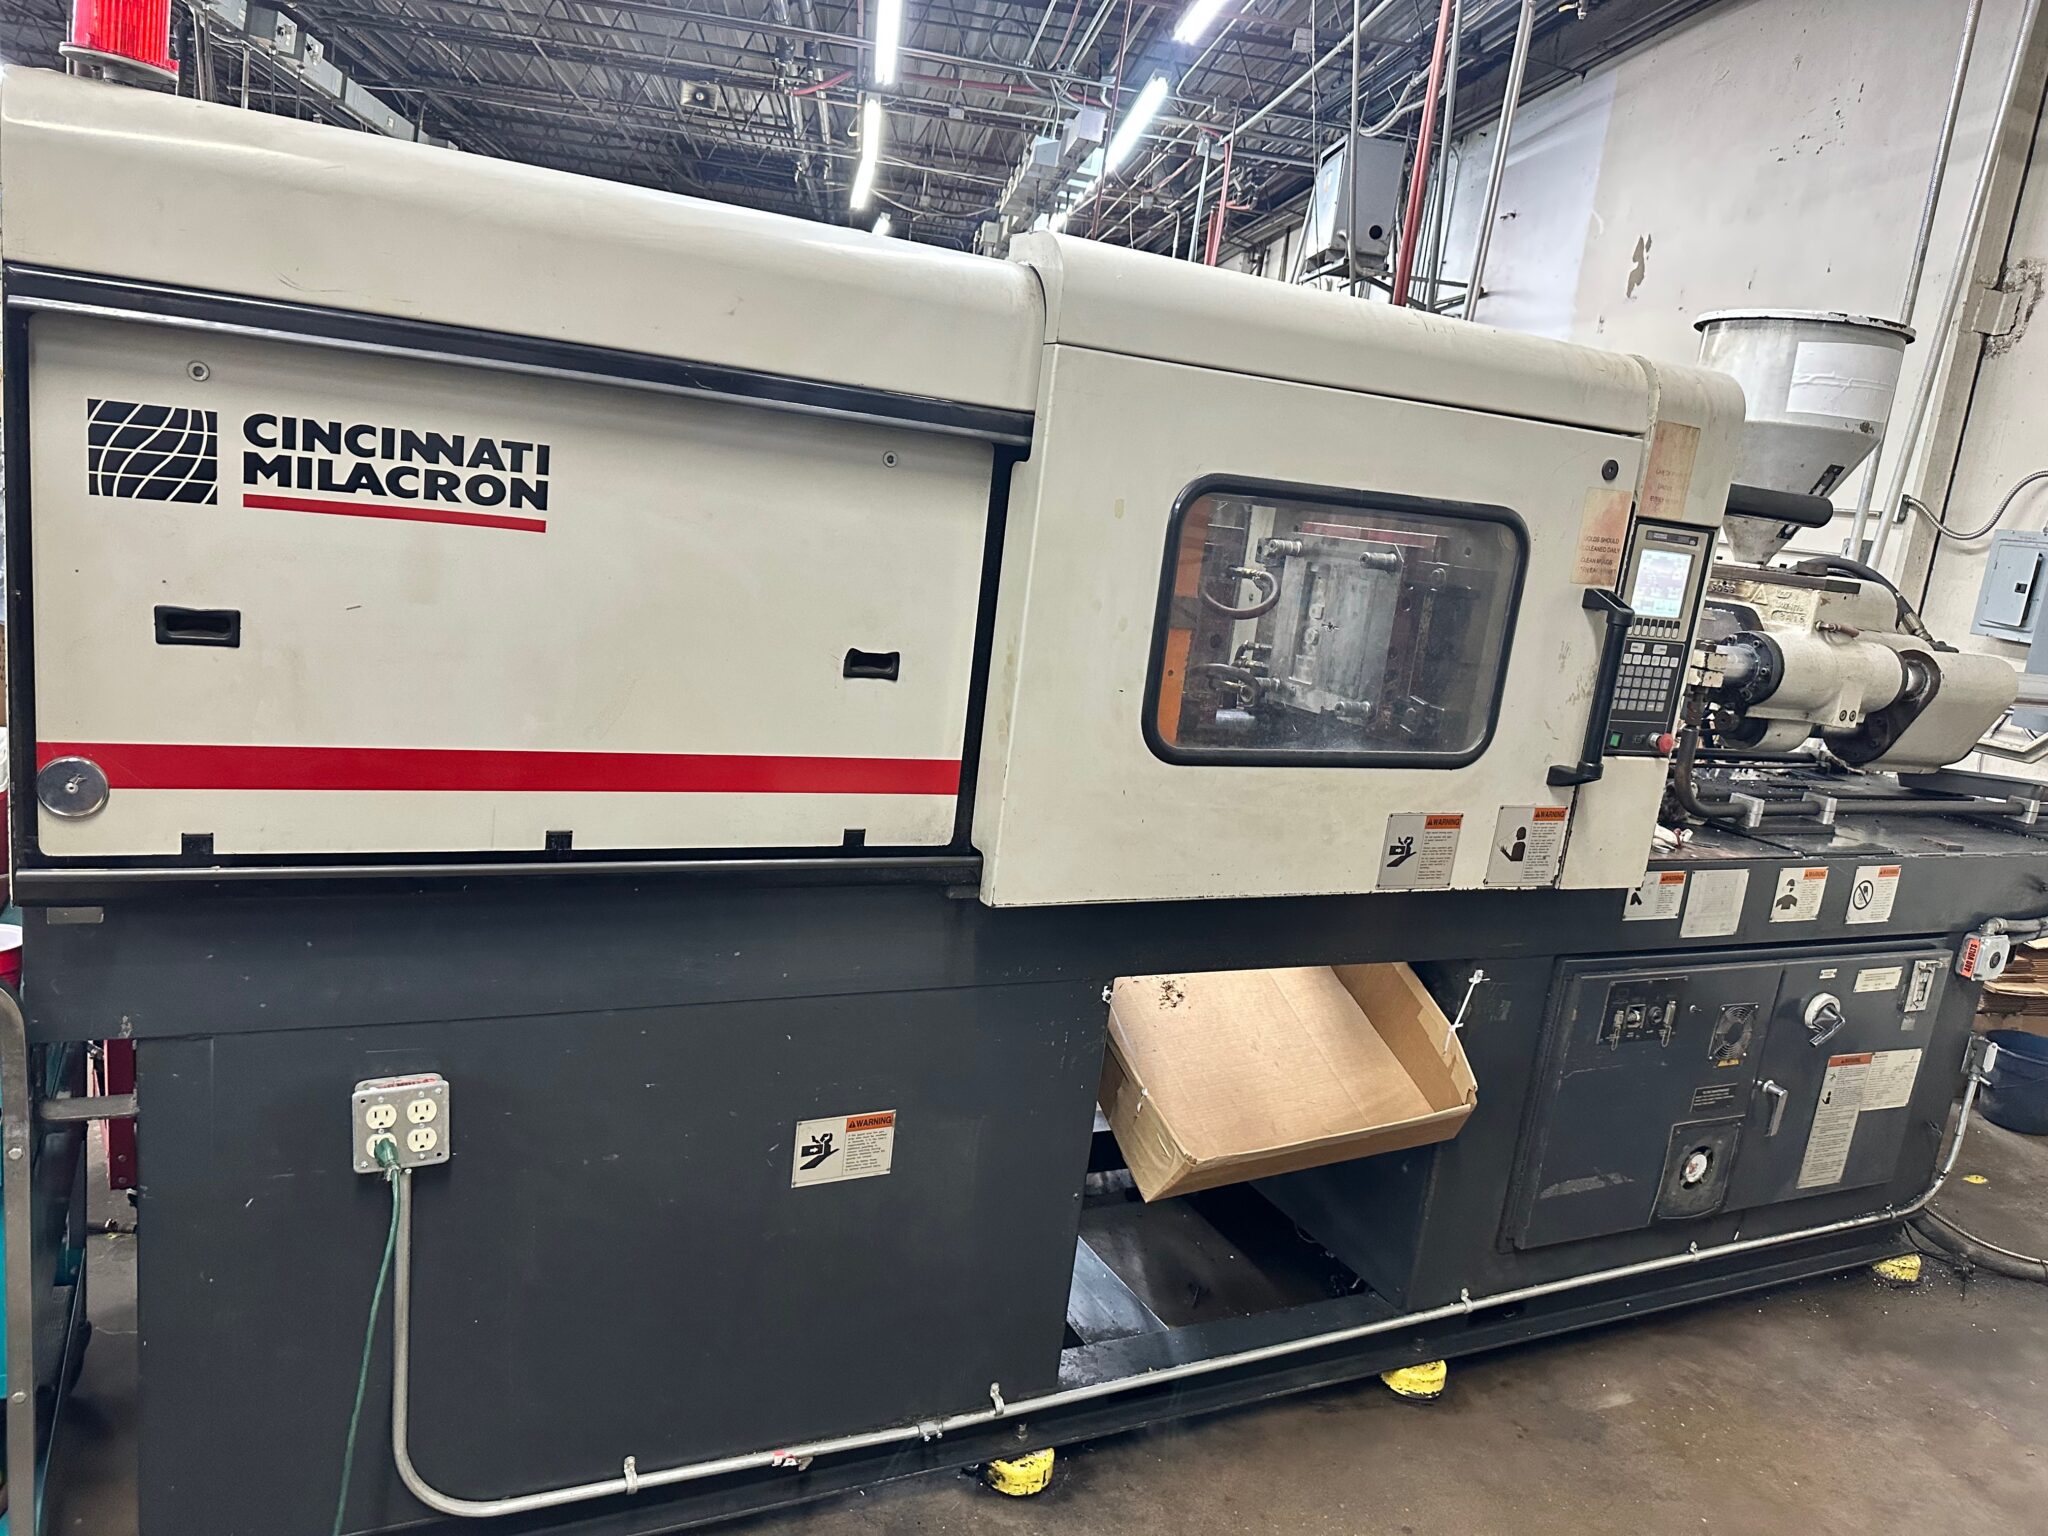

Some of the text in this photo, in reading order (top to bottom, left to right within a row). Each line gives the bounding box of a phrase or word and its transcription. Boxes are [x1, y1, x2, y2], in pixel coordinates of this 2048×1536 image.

[242, 412, 551, 476] CINCINNATI
[242, 451, 548, 511] MILACRON
[1584, 535, 1600, 543] OLDS
[1541, 810, 1565, 818] WARNING
[1433, 818, 1460, 826] WARNING
[1968, 943, 1978, 961] VOLTS
[856, 1116, 891, 1127] WARNING
